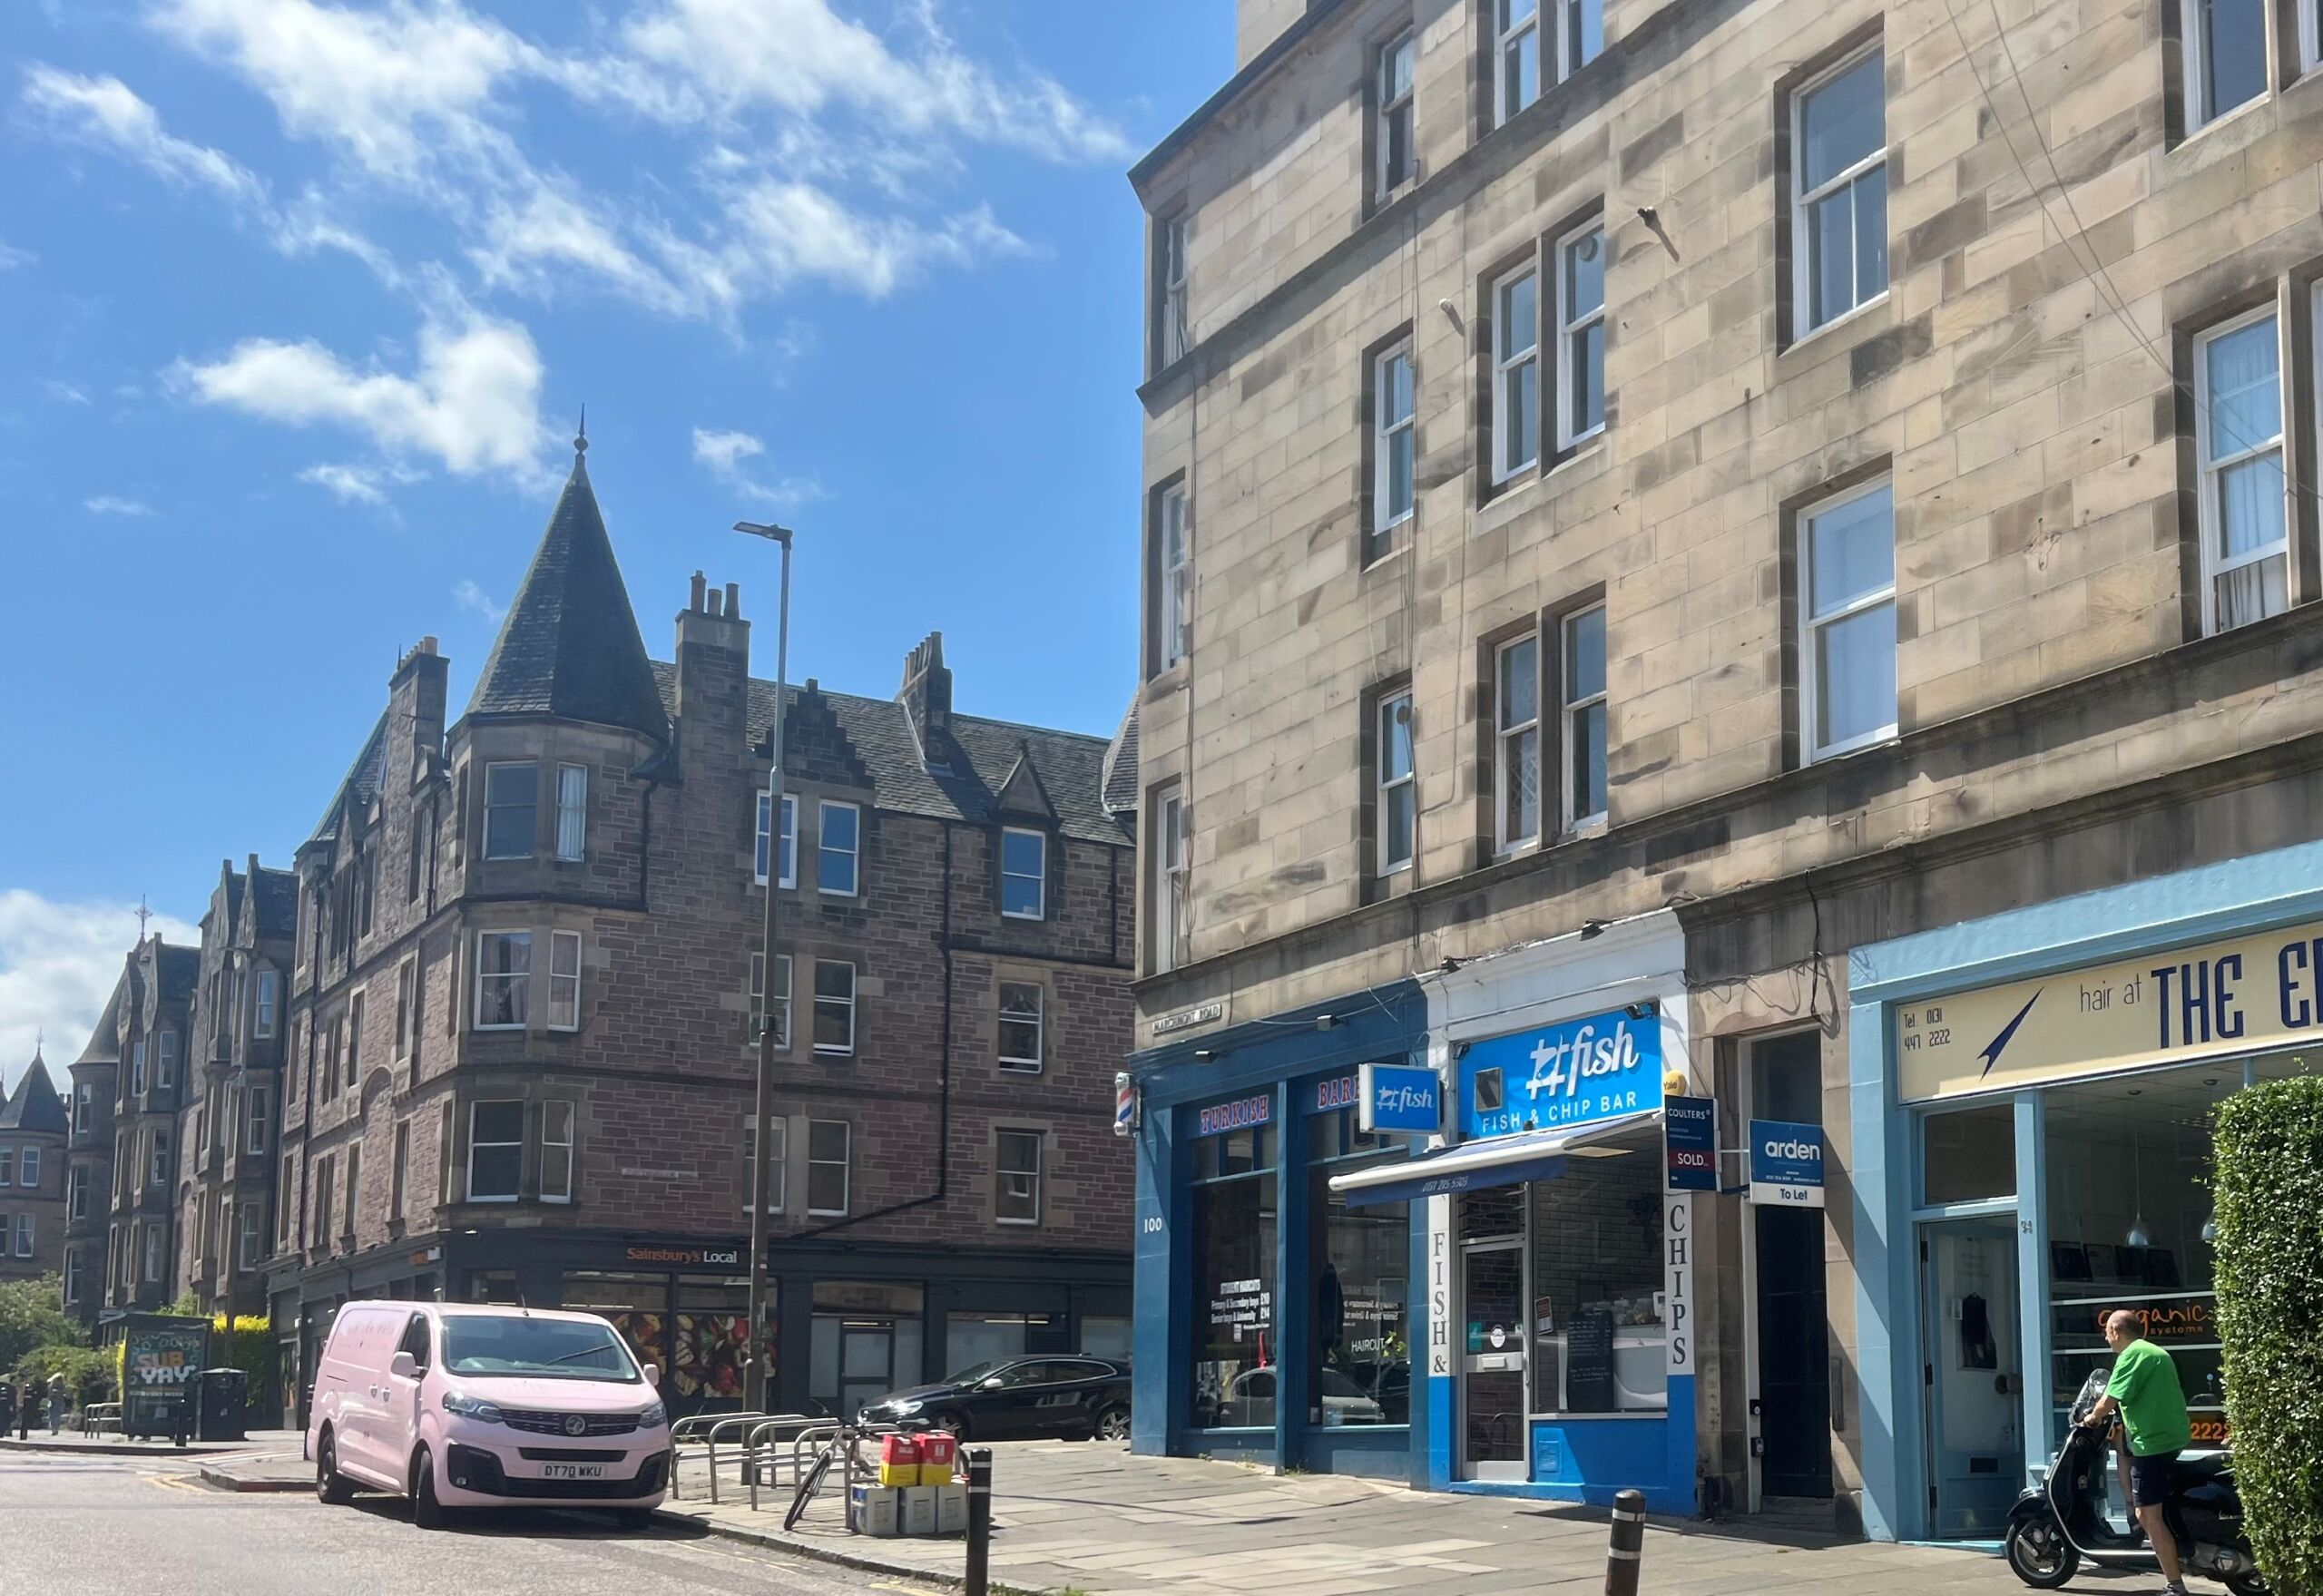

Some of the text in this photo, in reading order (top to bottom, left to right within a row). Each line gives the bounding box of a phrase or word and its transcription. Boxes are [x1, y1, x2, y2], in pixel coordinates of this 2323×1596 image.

[2080, 981, 2115, 1013] hair
[2123, 974, 2142, 1005] at
[2151, 953, 2245, 1050] THE
[1926, 1008, 1943, 1024] 0131
[1905, 1028, 1951, 1051] 447 2222
[1200, 1094, 1269, 1134] TURKISH
[1482, 1111, 1521, 1133] FISH
[1548, 1099, 1591, 1121] CHIP
[1601, 1091, 1637, 1112] BAR
[1668, 1107, 1707, 1121] COULTERS
[1764, 1138, 1821, 1161] arden
[1677, 1152, 1705, 1167] SOLD
[1779, 1188, 1808, 1201] To Let
[1144, 1218, 1162, 1234] 100
[626, 1247, 738, 1265] Sainsbury's Local
[1668, 1204, 1688, 1366] CHIPS
[1432, 1231, 1447, 1374] FISH &
[2097, 1299, 2210, 1338] oganic
[2150, 1326, 2204, 1337] systems
[137, 1350, 185, 1368] SUB
[141, 1364, 197, 1385] YAY
[544, 1465, 603, 1478] DT70 WKU
